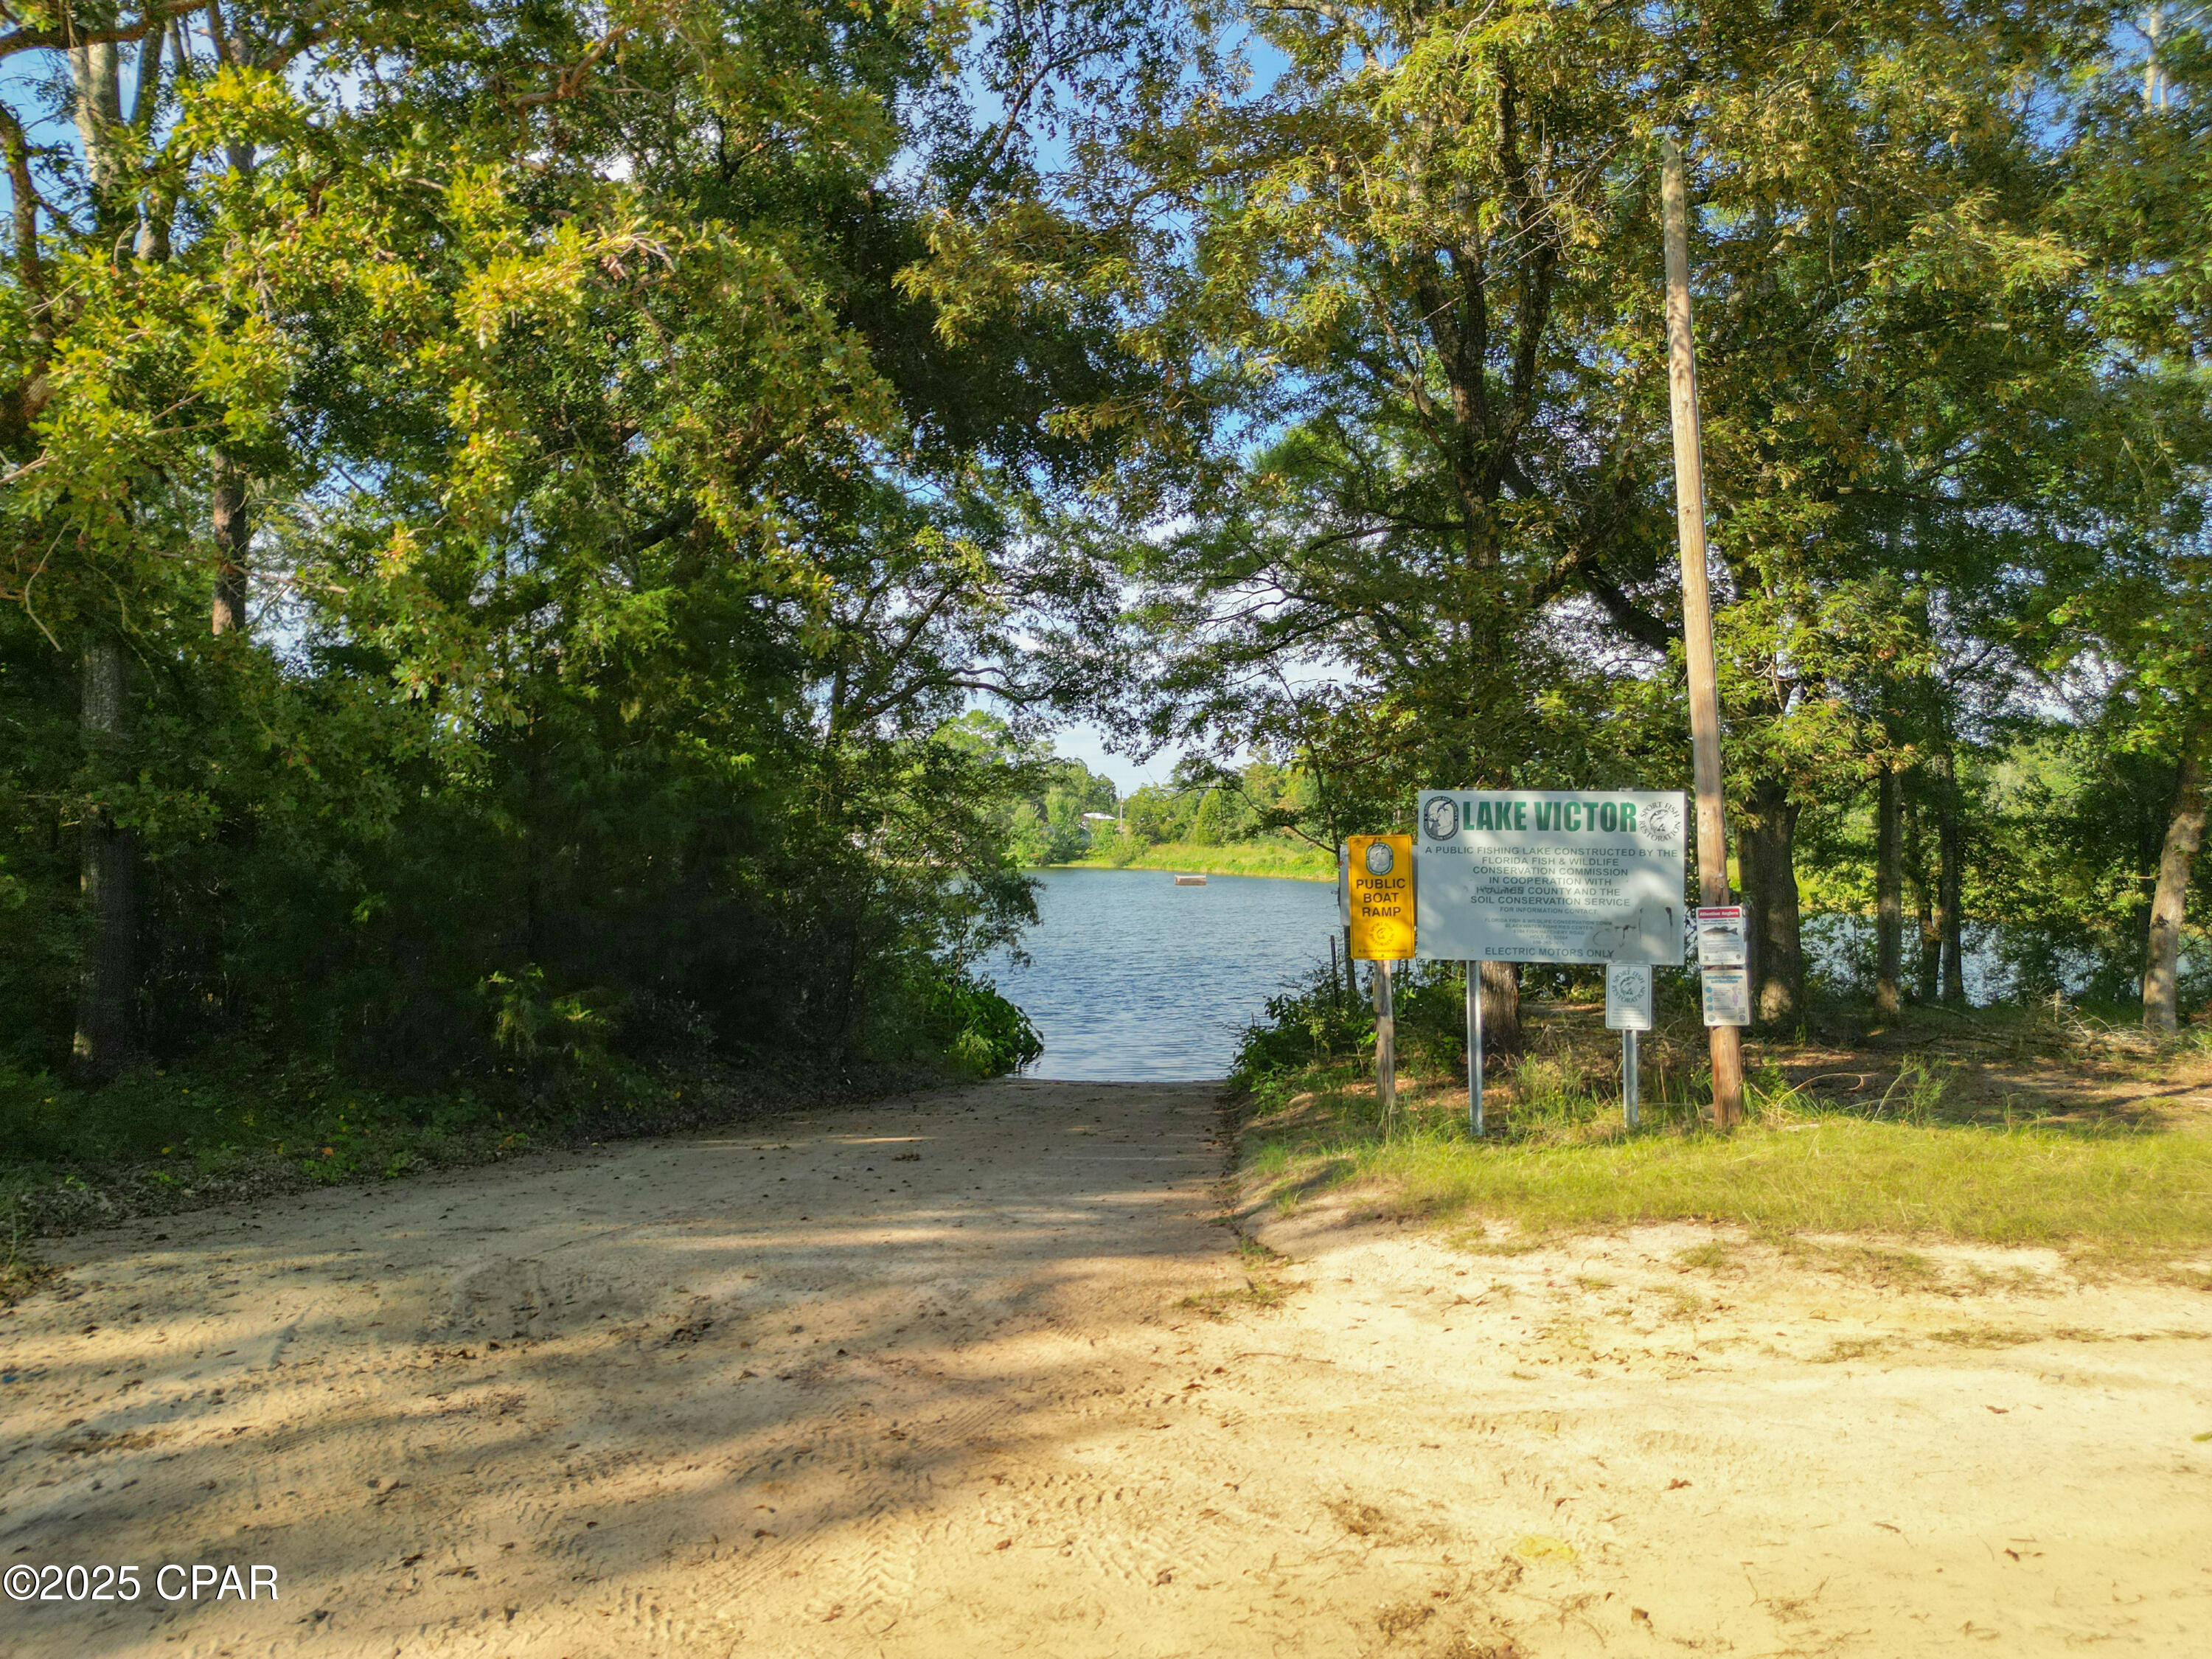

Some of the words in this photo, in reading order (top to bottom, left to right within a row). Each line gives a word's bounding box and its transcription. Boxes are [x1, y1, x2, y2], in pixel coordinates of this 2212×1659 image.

[1641, 801, 1662, 818] SPORT
[1664, 802, 1680, 818] FISH
[1463, 801, 1527, 830] LAKE
[1534, 801, 1637, 832] VICTOR
[1639, 821, 1681, 841] RESTORATION
[1477, 846, 1519, 855] FISHING
[1523, 847, 1552, 855] LAKE
[1554, 848, 1635, 856] CONSTRUCTED
[1639, 849, 1653, 857] BY
[1532, 857, 1555, 865] FISH
[1569, 858, 1618, 866] WILDLIFE
[1472, 866, 1555, 874] CONSERVATION
[1559, 868, 1628, 876] COMMISSION
[1357, 878, 1405, 889] PUBLIC
[1503, 877, 1581, 885] COOPERATION
[1528, 887, 1571, 895] COUNTY
[1363, 893, 1399, 902] BOAT
[1498, 897, 1580, 905] CONSERVATION
[1585, 898, 1630, 906] SERVICE
[1363, 907, 1401, 917] RAMP
[1485, 947, 1535, 956] ELECTRIC
[1539, 948, 1583, 956] MOTORS
[1587, 950, 1614, 958] ONLY
[1613, 970, 1630, 982] SPORT
[1632, 971, 1645, 984] FISH
